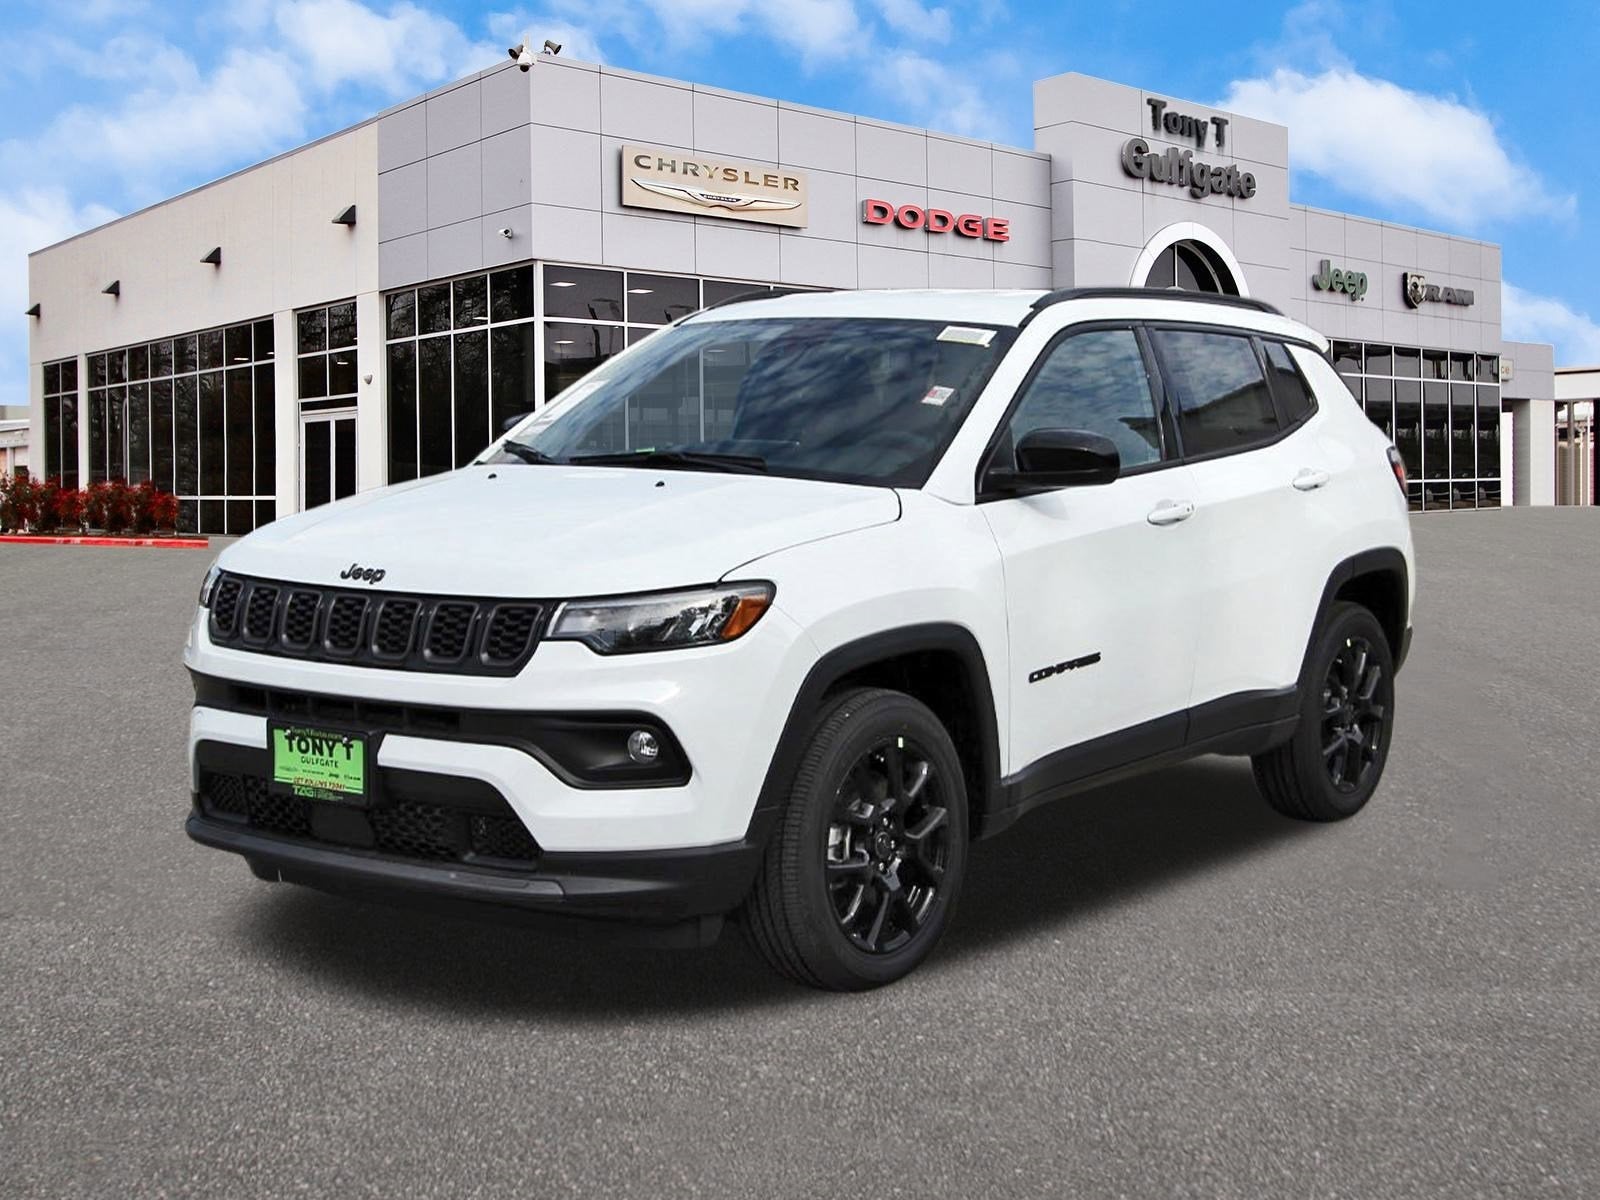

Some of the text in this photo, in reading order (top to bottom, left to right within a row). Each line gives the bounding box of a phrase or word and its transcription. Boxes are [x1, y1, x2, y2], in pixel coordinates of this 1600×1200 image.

[1146, 98, 1229, 147] Tony T
[633, 154, 801, 192] CHRYSLER
[1121, 138, 1256, 199] Gulfgate
[862, 198, 1010, 242] DODGE
[1312, 259, 1369, 301] Jeep
[1424, 284, 1475, 306] RAM
[340, 563, 386, 585] Jeep
[284, 734, 354, 761] TONY T
[300, 756, 339, 769] GULFGATE
